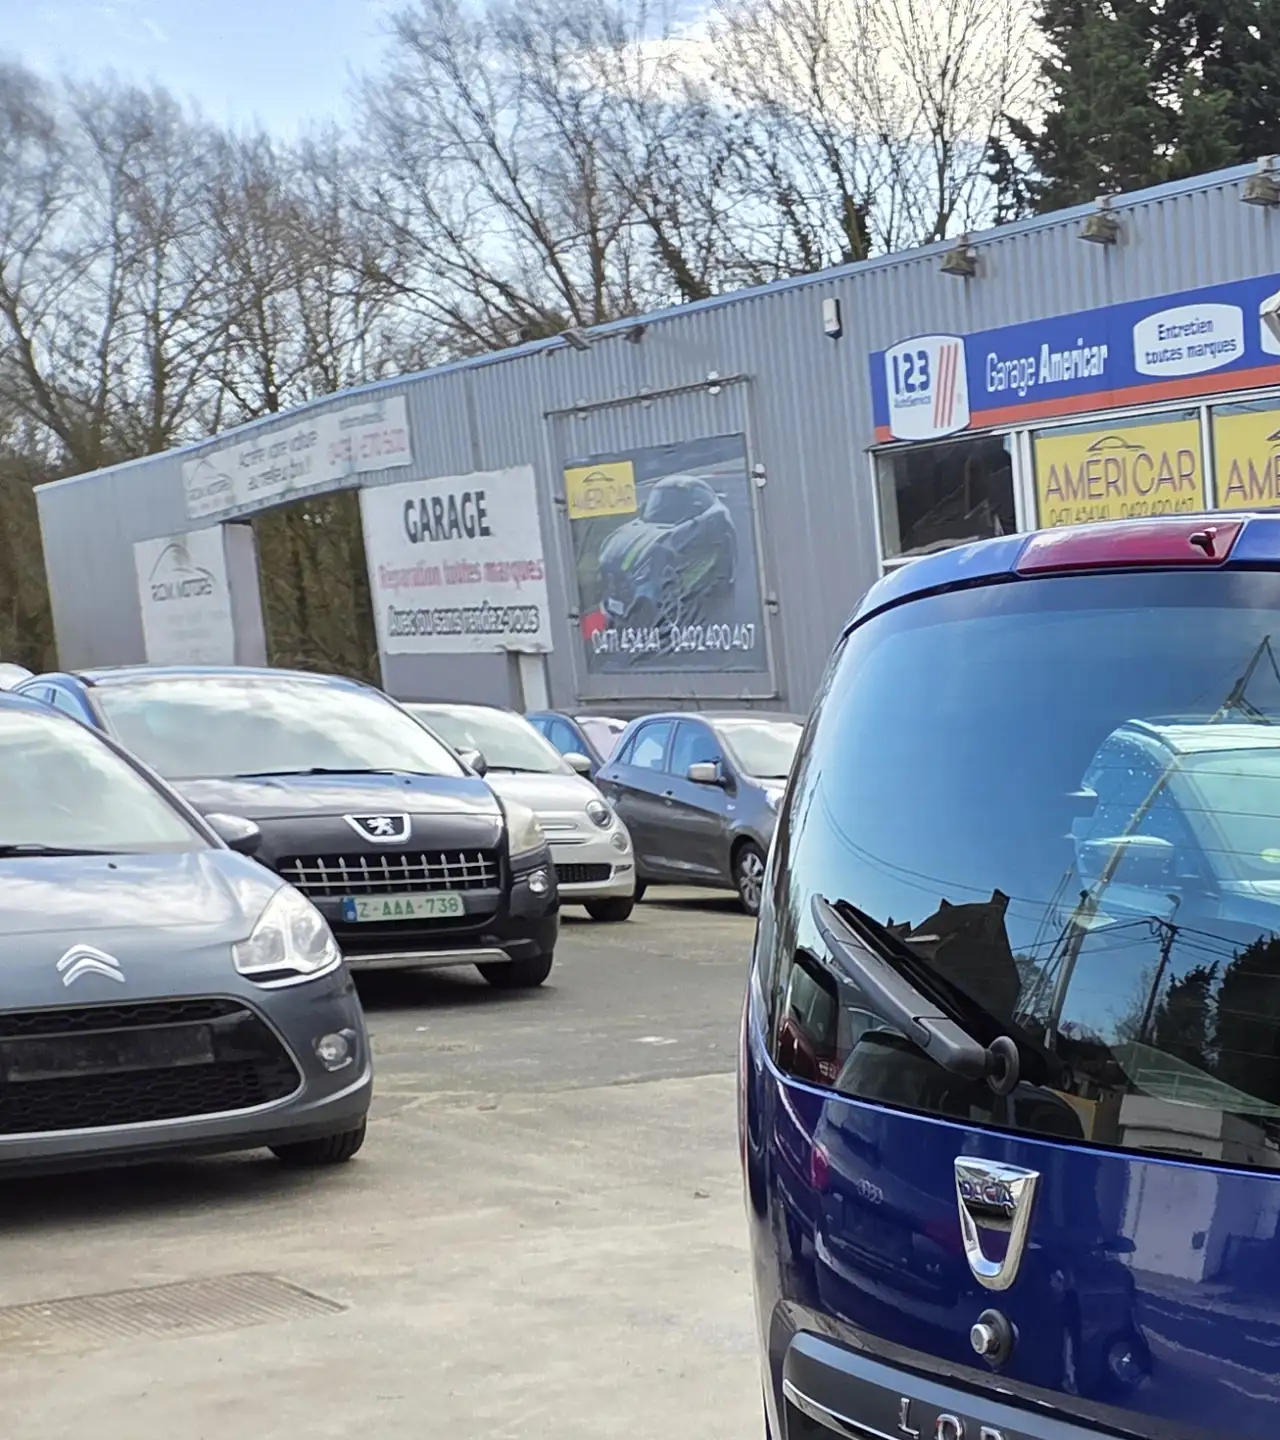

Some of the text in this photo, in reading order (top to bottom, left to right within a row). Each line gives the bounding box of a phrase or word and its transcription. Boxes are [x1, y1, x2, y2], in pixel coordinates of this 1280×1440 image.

[1145, 338, 1237, 365] toutes marques
[1158, 318, 1213, 341] Entretien
[893, 350, 931, 395] 123
[986, 337, 1108, 397] Garage Americar
[404, 490, 491, 543] GARAGE
